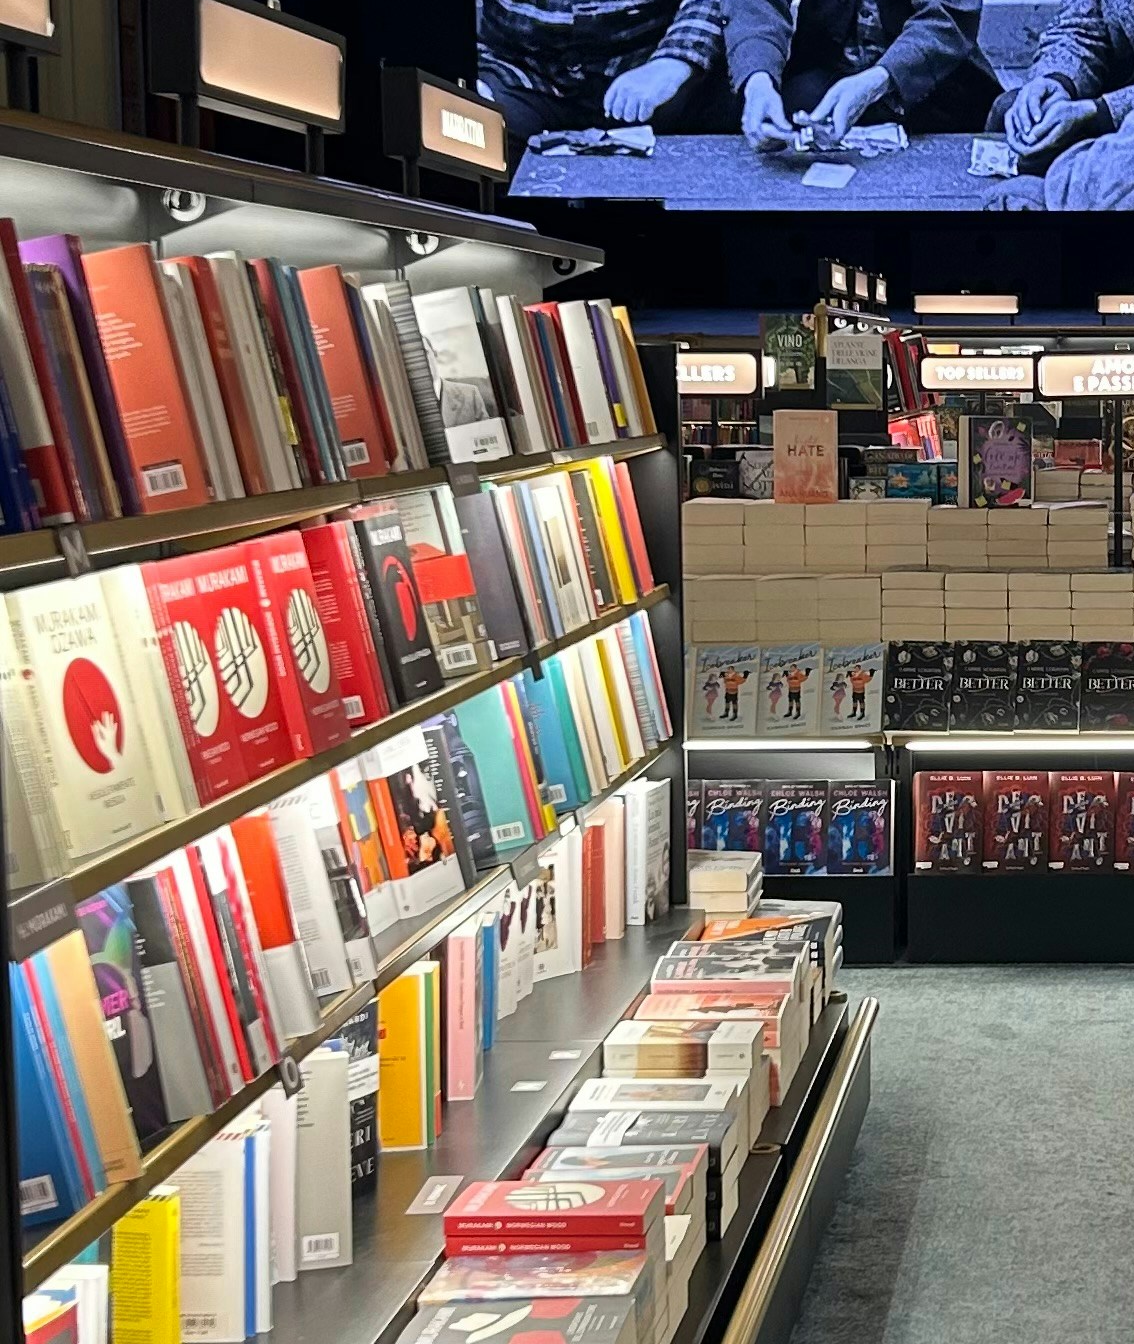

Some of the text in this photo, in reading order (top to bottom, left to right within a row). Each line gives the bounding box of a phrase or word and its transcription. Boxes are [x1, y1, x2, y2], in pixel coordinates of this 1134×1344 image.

[777, 334, 803, 348] VINO
[935, 366, 1025, 381] TOP SELLERS
[1073, 376, 1085, 392] E
[787, 443, 825, 458] HATE
[196, 565, 249, 595] MURAKAMI
[51, 629, 98, 654] OZAWA
[701, 652, 756, 673] Icebreaker
[765, 648, 818, 672] Icebreaker
[829, 649, 881, 672] Icebreaker
[893, 676, 945, 691] BETTER
[958, 676, 1011, 691] BETTER
[1022, 676, 1073, 691] BETTER
[736, 789, 763, 797] WALSH
[798, 789, 826, 797] WALSH
[861, 789, 888, 797] WALSH
[706, 797, 763, 817] Binding
[769, 797, 826, 818] Binding
[832, 797, 888, 817] Binding
